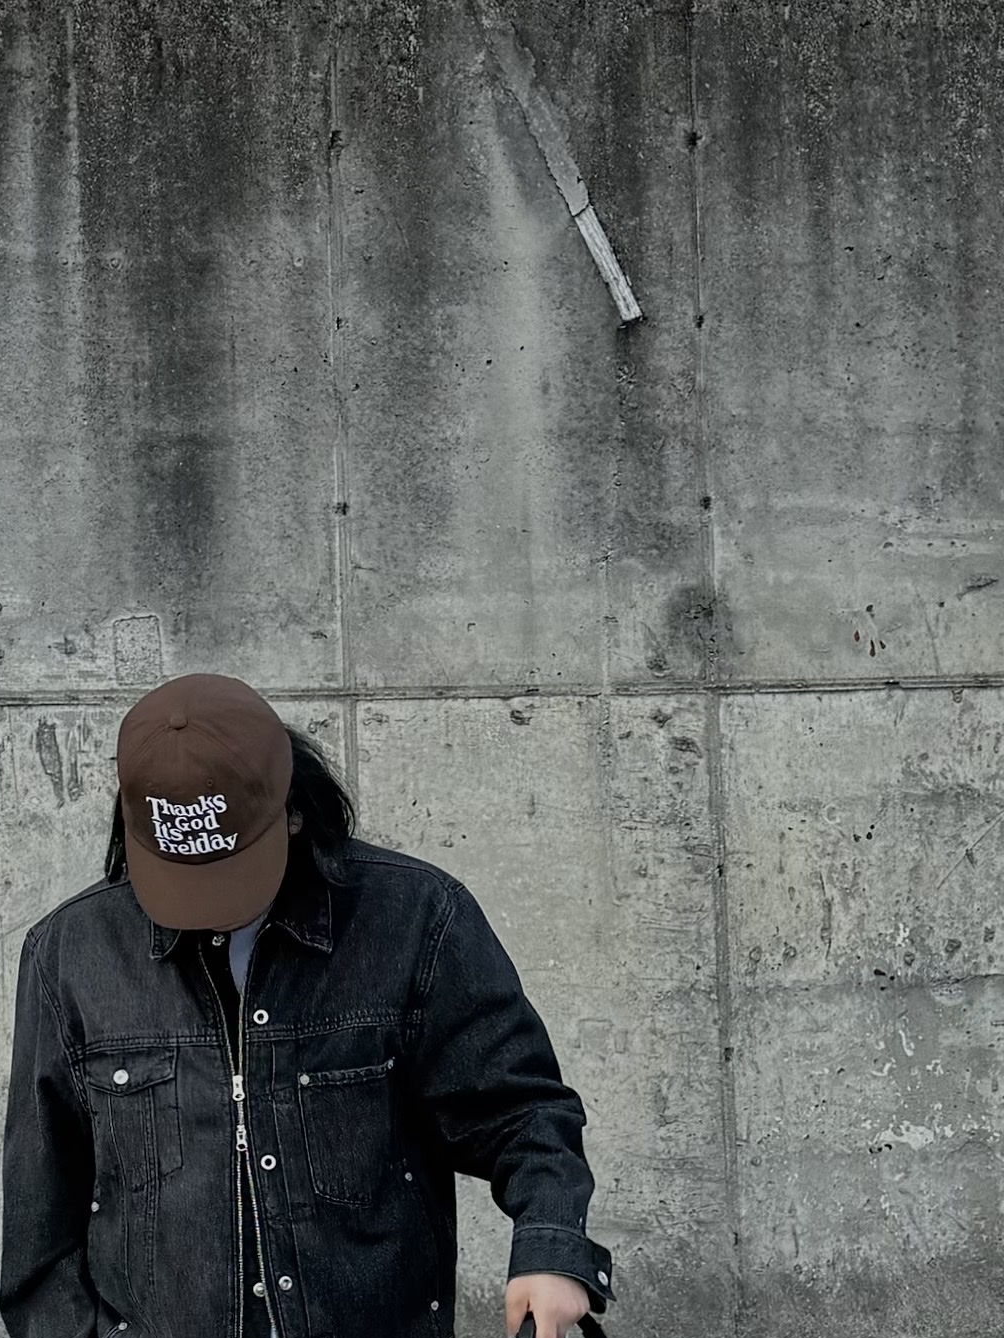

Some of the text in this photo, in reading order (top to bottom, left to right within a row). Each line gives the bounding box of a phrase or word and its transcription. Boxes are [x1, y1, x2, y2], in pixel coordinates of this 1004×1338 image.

[153, 820, 184, 841] It's
[175, 809, 220, 831] God
[156, 832, 238, 855] Freiday
